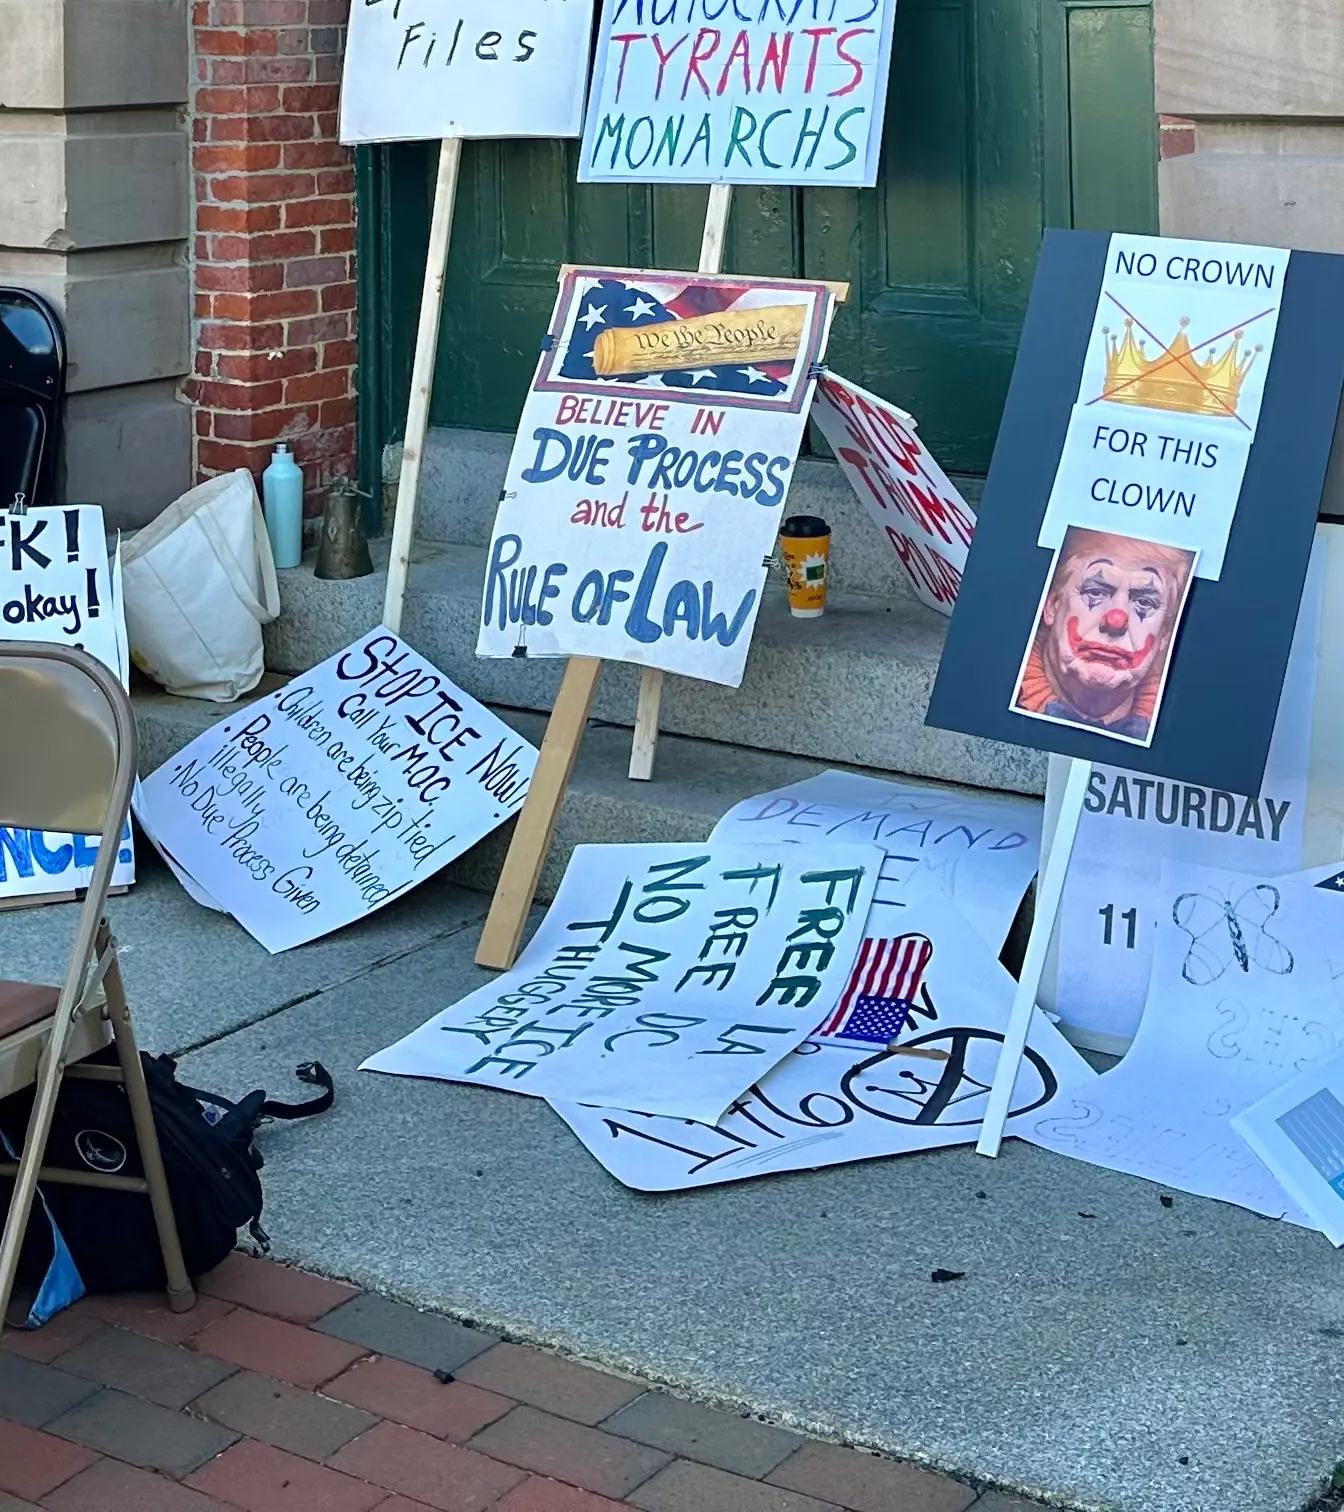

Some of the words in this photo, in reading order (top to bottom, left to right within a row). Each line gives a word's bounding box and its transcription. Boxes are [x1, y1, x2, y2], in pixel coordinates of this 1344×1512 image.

[397, 23, 537, 70] Files
[610, 27, 875, 105] TYRANTS
[591, 104, 866, 172] MONARCHS
[1115, 250, 1158, 277] NO
[1165, 256, 1276, 288] CROWN
[634, 330, 671, 350] We
[674, 325, 704, 352] the
[705, 319, 777, 348] People
[556, 395, 669, 431] BELIEVE
[690, 409, 725, 436] IN
[818, 379, 937, 488] STOP
[1092, 426, 1148, 458] FOR
[1157, 436, 1220, 469] THIS
[521, 428, 614, 485] DUE
[627, 433, 794, 507] PROCESS
[1090, 477, 1196, 517] CLOWN
[570, 491, 627, 529] and
[640, 494, 704, 534] the
[484, 534, 567, 632] RULE
[572, 568, 635, 625] OF
[625, 541, 756, 647] LAW
[885, 525, 962, 605] POWE
[3, 567, 101, 635] okay!
[337, 693, 379, 728] Call
[367, 715, 400, 755] Your
[405, 691, 482, 762] ICE
[208, 744, 267, 829] illegally
[230, 713, 289, 781] People
[280, 776, 311, 809] are
[302, 790, 345, 858] being
[335, 839, 413, 910] detained
[277, 686, 331, 748] Children
[326, 740, 353, 773] are
[346, 753, 381, 810] being
[371, 797, 404, 834] zip
[397, 809, 456, 871] tied
[1083, 771, 1291, 842] SATURDAY
[169, 759, 205, 797] No
[191, 785, 225, 834] Due
[220, 820, 276, 881] Process
[272, 866, 321, 915] Given
[735, 796, 1032, 853] DEMAND
[632, 855, 711, 924] NO
[440, 875, 634, 1045] THUGGERY
[674, 861, 783, 993] FREE
[756, 865, 866, 1008] FREE
[1098, 903, 1137, 949] 11
[558, 941, 671, 1020] MORE
[464, 1020, 597, 1080] ICE
